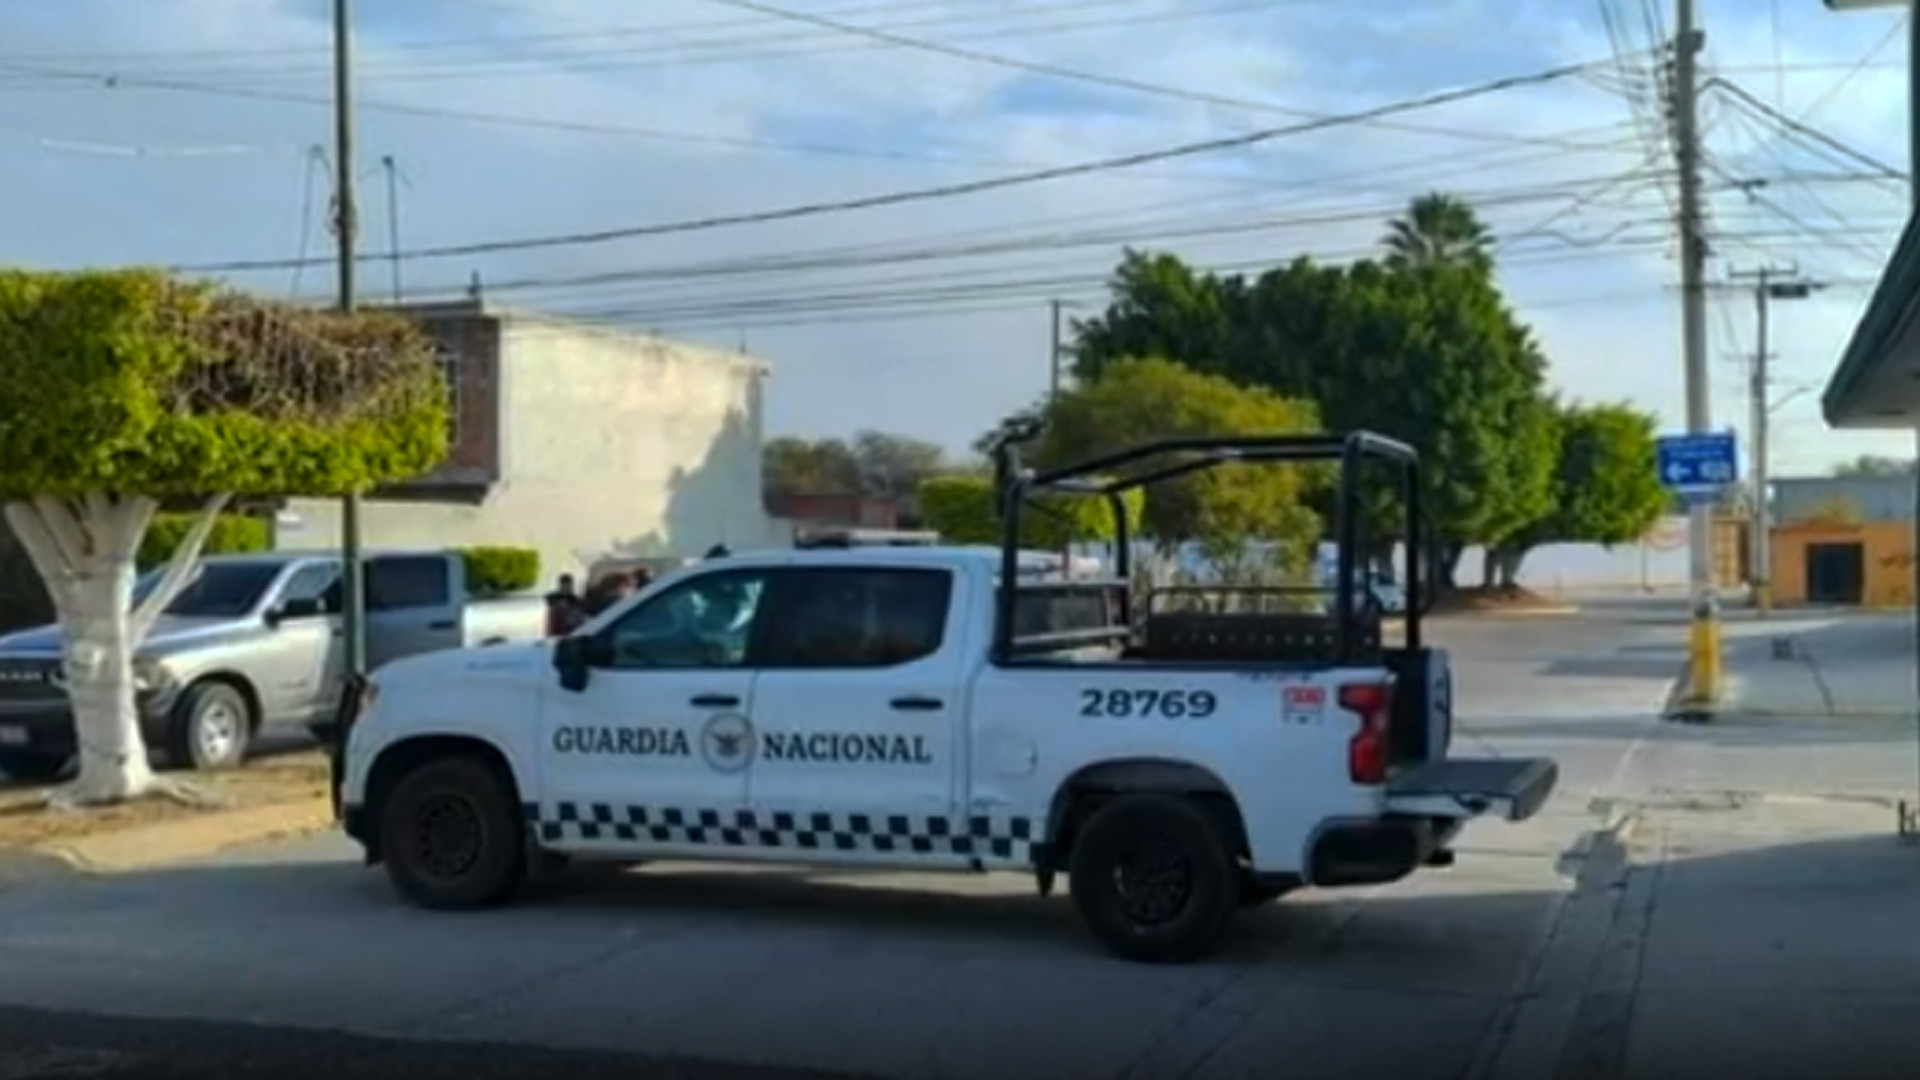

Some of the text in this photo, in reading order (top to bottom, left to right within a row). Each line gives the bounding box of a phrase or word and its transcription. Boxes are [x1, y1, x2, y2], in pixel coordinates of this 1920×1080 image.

[1080, 689, 1217, 718] 28769
[553, 726, 932, 764] GUARDIA NACIONAL
